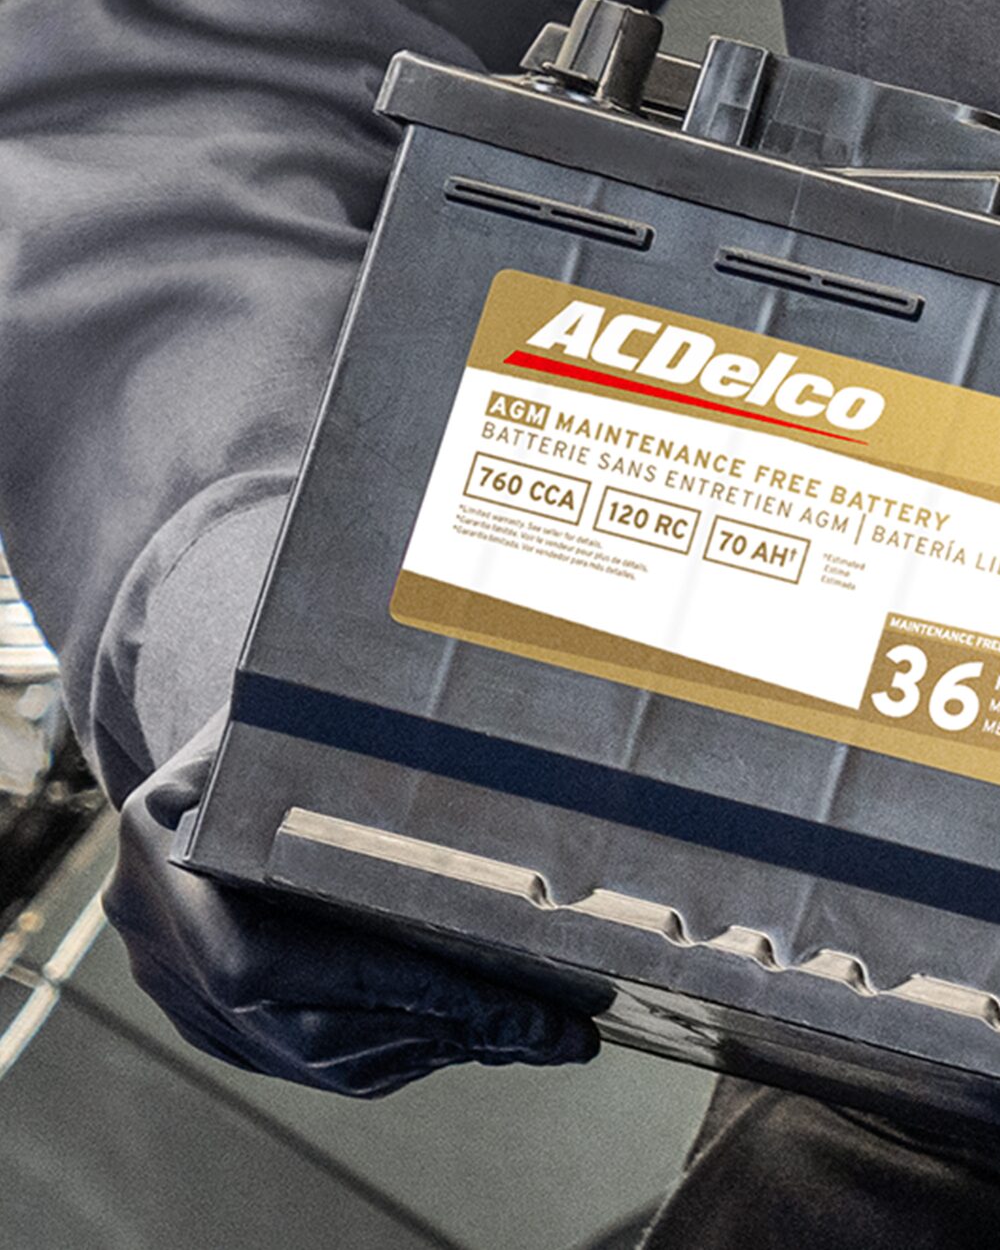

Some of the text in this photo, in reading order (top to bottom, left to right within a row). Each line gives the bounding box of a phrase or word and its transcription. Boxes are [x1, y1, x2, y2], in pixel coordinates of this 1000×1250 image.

[526, 300, 885, 430] ACDelco
[481, 421, 850, 533] BATTERIE SANS ENTRETIEN AGM
[490, 396, 951, 532] AGM MAINTENANCE FREE BATTERY
[479, 466, 575, 511] 760 CCA
[608, 502, 688, 539] 120 RC
[719, 530, 747, 555] 70
[871, 525, 966, 565] BATERÍA
[890, 617, 974, 646] MAINTENANCE
[871, 644, 984, 731] 36
